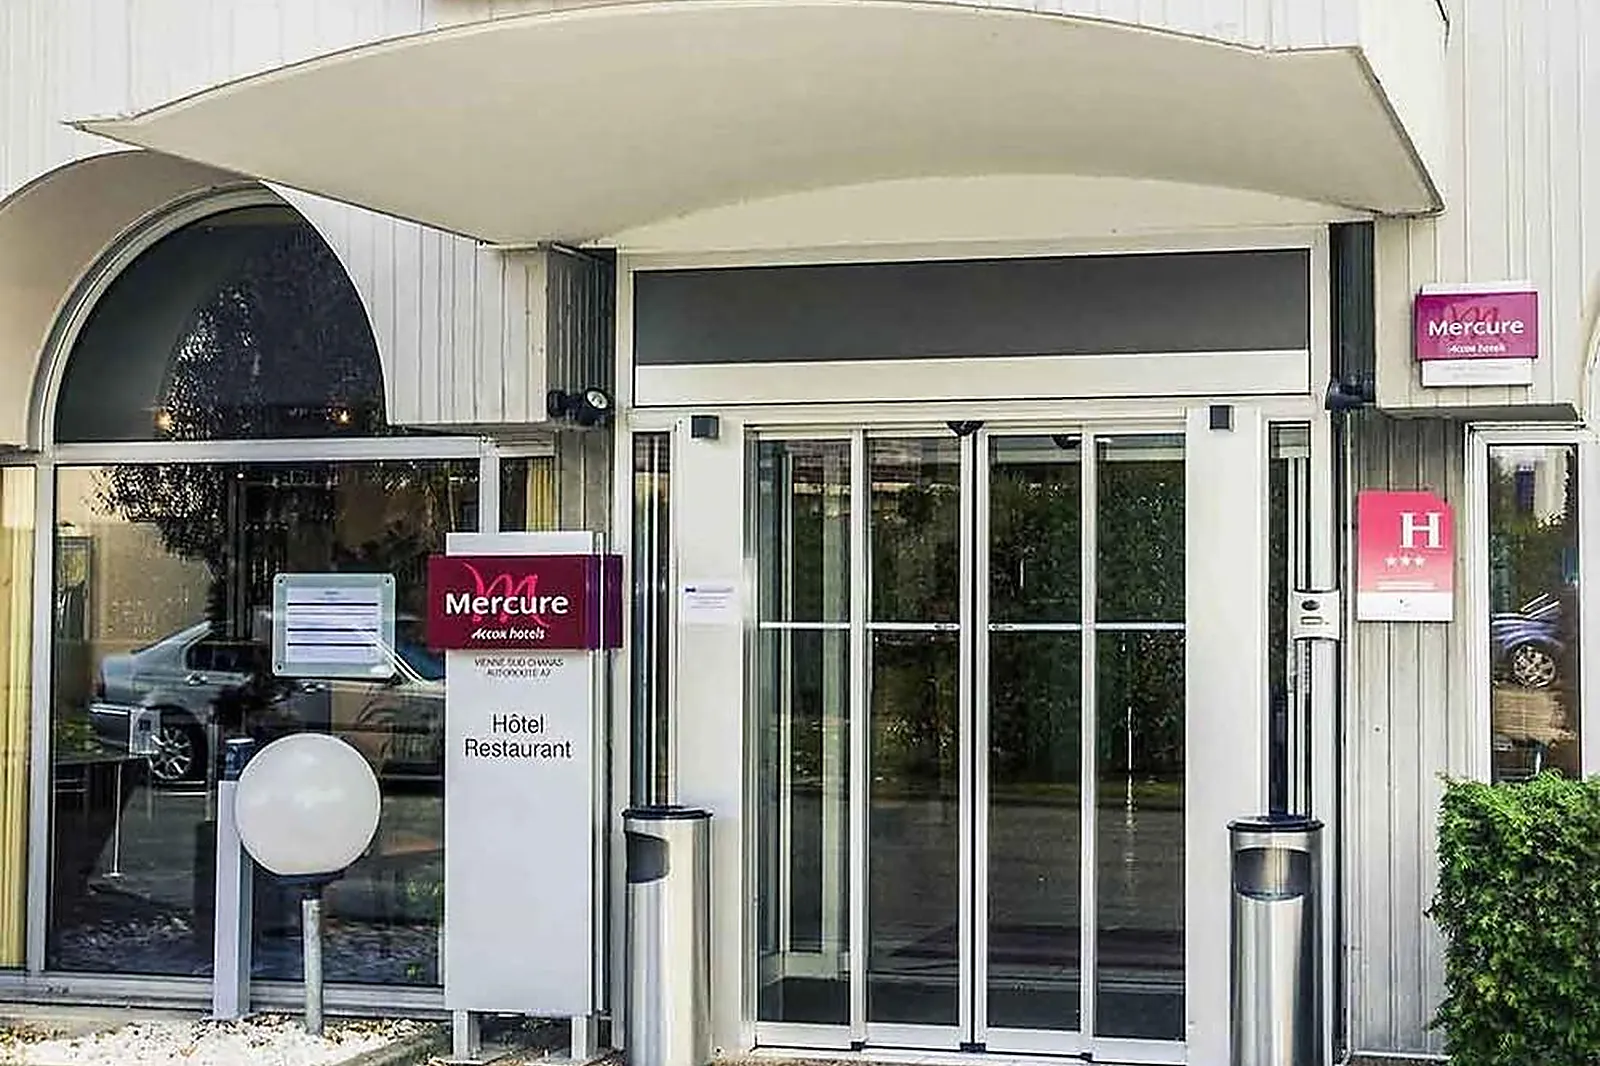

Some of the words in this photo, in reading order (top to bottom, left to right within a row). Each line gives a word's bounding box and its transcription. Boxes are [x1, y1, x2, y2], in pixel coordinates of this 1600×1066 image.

[1428, 320, 1524, 337] Mercure
[1400, 511, 1443, 549] H
[445, 592, 569, 615] Mercure
[509, 626, 545, 640] hotels
[492, 713, 544, 734] Hôtel
[465, 738, 572, 758] Restaurant
